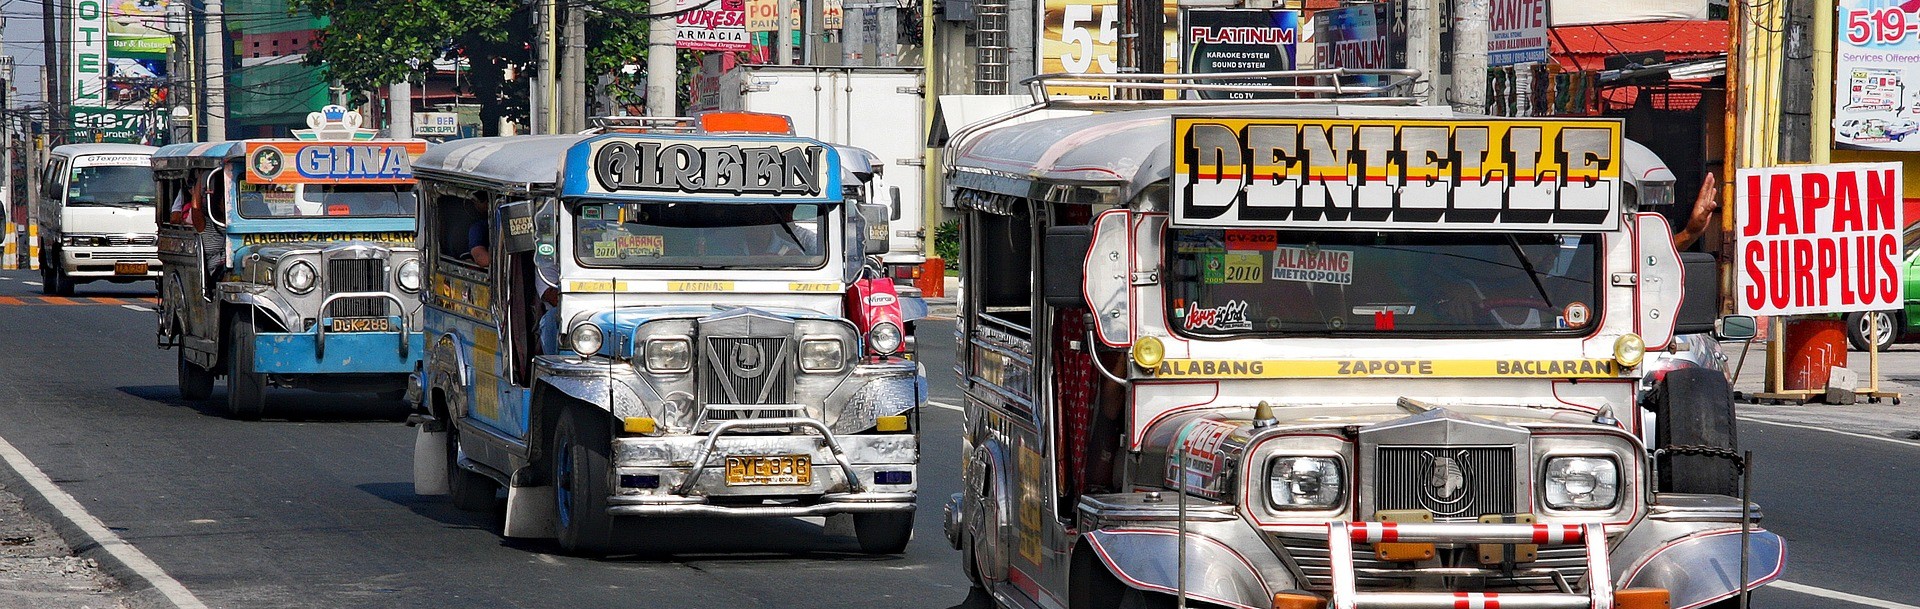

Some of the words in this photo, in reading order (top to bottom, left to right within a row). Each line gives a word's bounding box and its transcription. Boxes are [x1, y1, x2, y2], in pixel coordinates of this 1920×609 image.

[1848, 9, 1920, 43] 519-
[1191, 27, 1293, 44] PLATINUM
[1316, 35, 1387, 69] PLATINUM
[1843, 52, 1883, 62] Services
[296, 145, 414, 179] GINA
[595, 141, 823, 197] AIREEN
[1184, 123, 1613, 224] DENIELLE
[1743, 169, 1895, 237] JAPAN
[510, 217, 532, 226] EVERY
[511, 223, 533, 232] DROP
[618, 236, 662, 249] ALABANG
[596, 247, 615, 257] 2010
[1278, 248, 1350, 272] ALABANG
[1227, 266, 1261, 281] 2010
[1274, 268, 1351, 284] METROPOLIS
[1745, 233, 1898, 311] SURPLUS
[333, 319, 358, 332] DGK
[1159, 361, 1264, 375] ALABANG
[1338, 361, 1433, 375] ZAPOTE
[1497, 361, 1612, 375] BACLARAN
[728, 459, 766, 475] PYE
